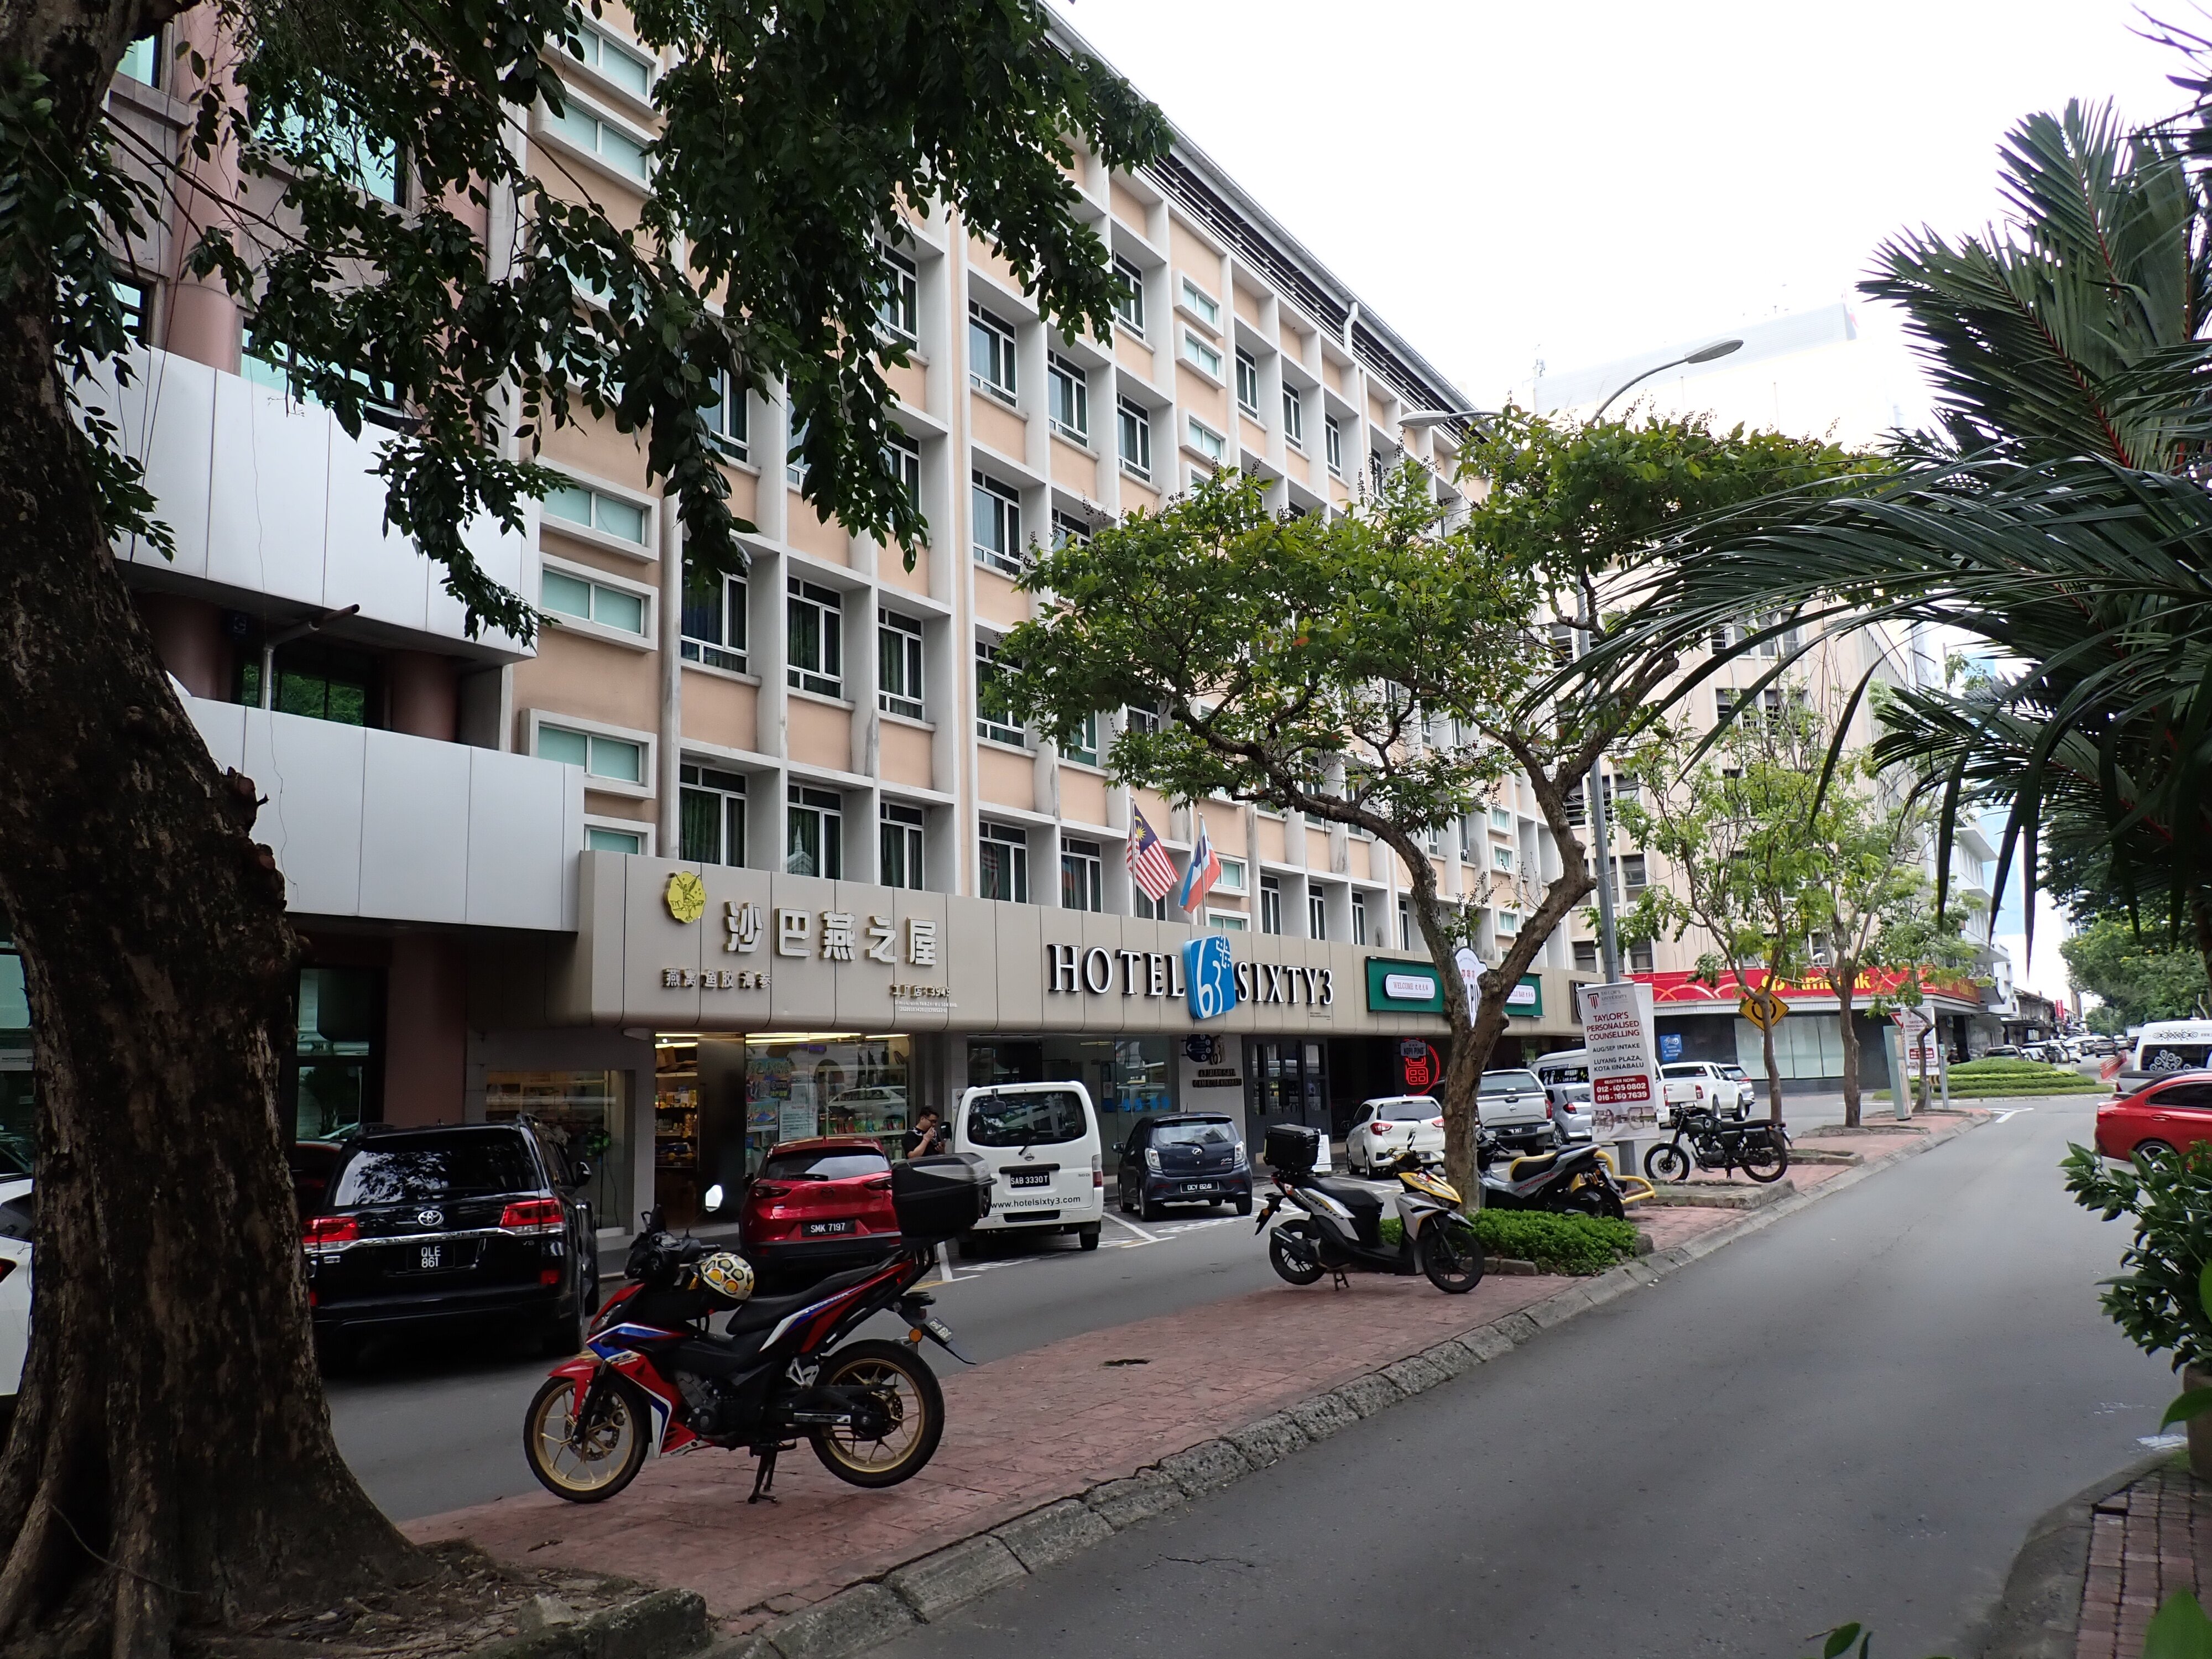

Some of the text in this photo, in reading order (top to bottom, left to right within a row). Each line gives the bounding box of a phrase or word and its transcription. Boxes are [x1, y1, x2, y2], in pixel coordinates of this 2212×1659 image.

[724, 901, 937, 966] 沙巴燕之屋
[1047, 944, 1185, 997] HOTEL
[1234, 961, 1334, 1005] SIXTY3
[1393, 982, 1413, 990] WELCOME
[1593, 1011, 1629, 1022] TAYLOR'S
[1587, 1021, 1640, 1032] PERSONALISED
[1589, 1030, 1640, 1041] COUNSELLING
[1611, 1062, 1644, 1070] KINABALU
[810, 1223, 846, 1233] SMK 7197
[421, 1245, 441, 1258] QLE
[421, 1256, 439, 1268] 861
